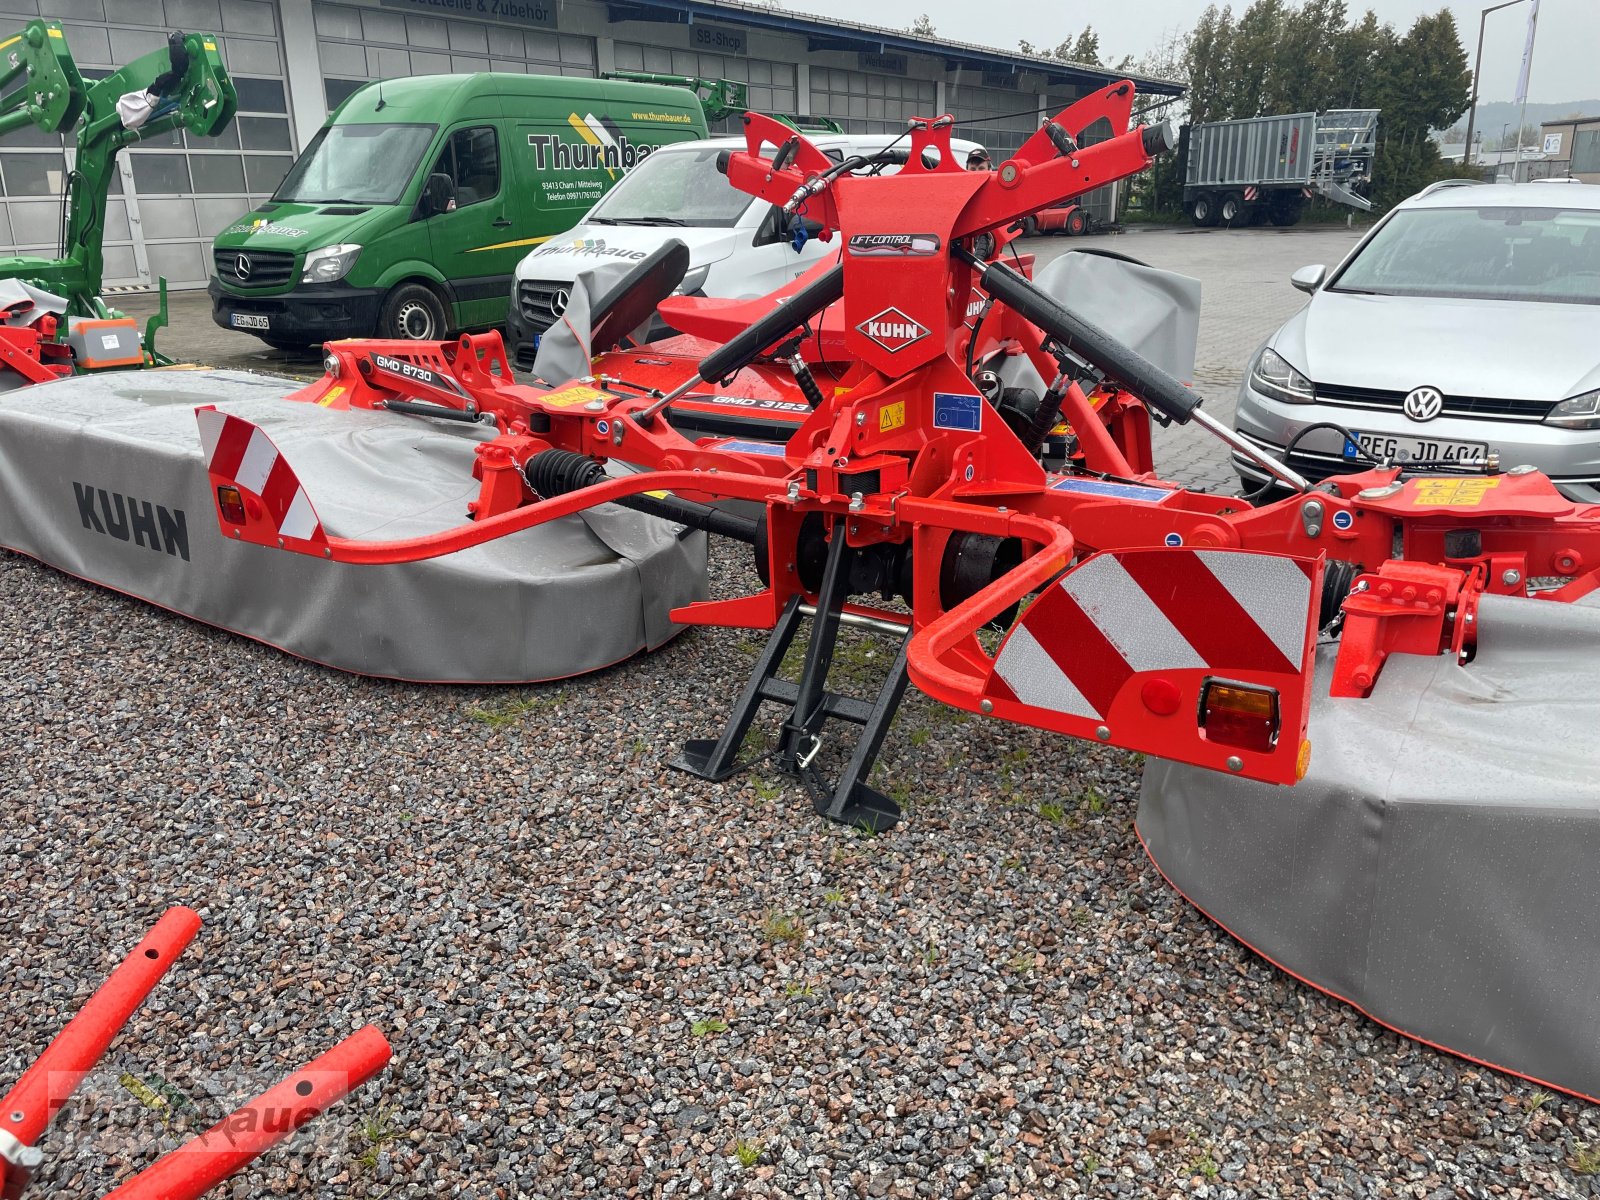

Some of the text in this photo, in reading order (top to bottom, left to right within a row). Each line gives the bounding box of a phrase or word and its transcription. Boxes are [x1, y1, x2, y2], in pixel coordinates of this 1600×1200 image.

[492, 0, 549, 21] Zubehör
[697, 29, 741, 50] SB-Shop
[632, 112, 692, 122] www.thurnbauer.de
[528, 134, 657, 170] Thurnba
[542, 182, 559, 190] 93413
[547, 193, 567, 201] Telefon
[850, 235, 913, 245] LIFT-CONTROL
[532, 246, 647, 260] Thurnbaue
[259, 318, 268, 328] 65
[868, 322, 918, 339] KUHN
[376, 356, 432, 382] GMD 8730
[712, 396, 808, 411] GMD 3123
[1359, 435, 1398, 458] REG
[1412, 442, 1438, 461] JD
[73, 481, 190, 562] KUHN
